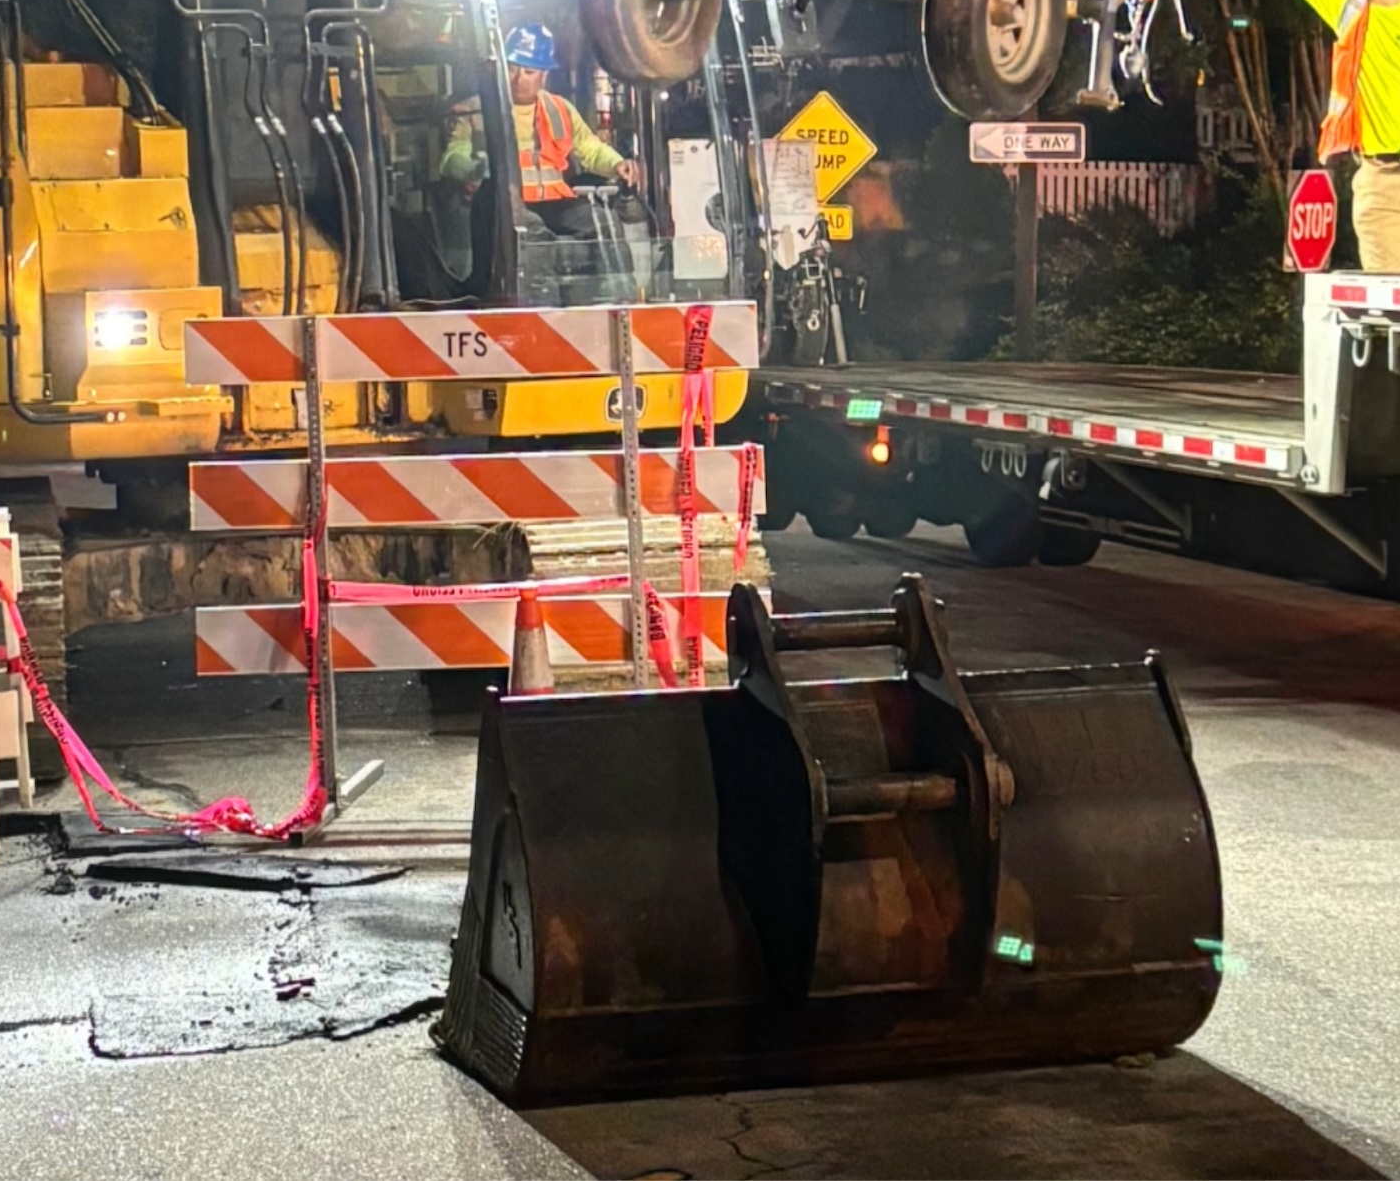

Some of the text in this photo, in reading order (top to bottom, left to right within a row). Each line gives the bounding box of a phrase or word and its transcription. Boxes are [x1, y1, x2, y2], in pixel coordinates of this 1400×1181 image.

[796, 129, 850, 145] SPEED
[1004, 136, 1070, 149] ONE WAY
[813, 154, 847, 170] UMP
[1292, 202, 1334, 240] STOP
[443, 331, 487, 359] TFS
